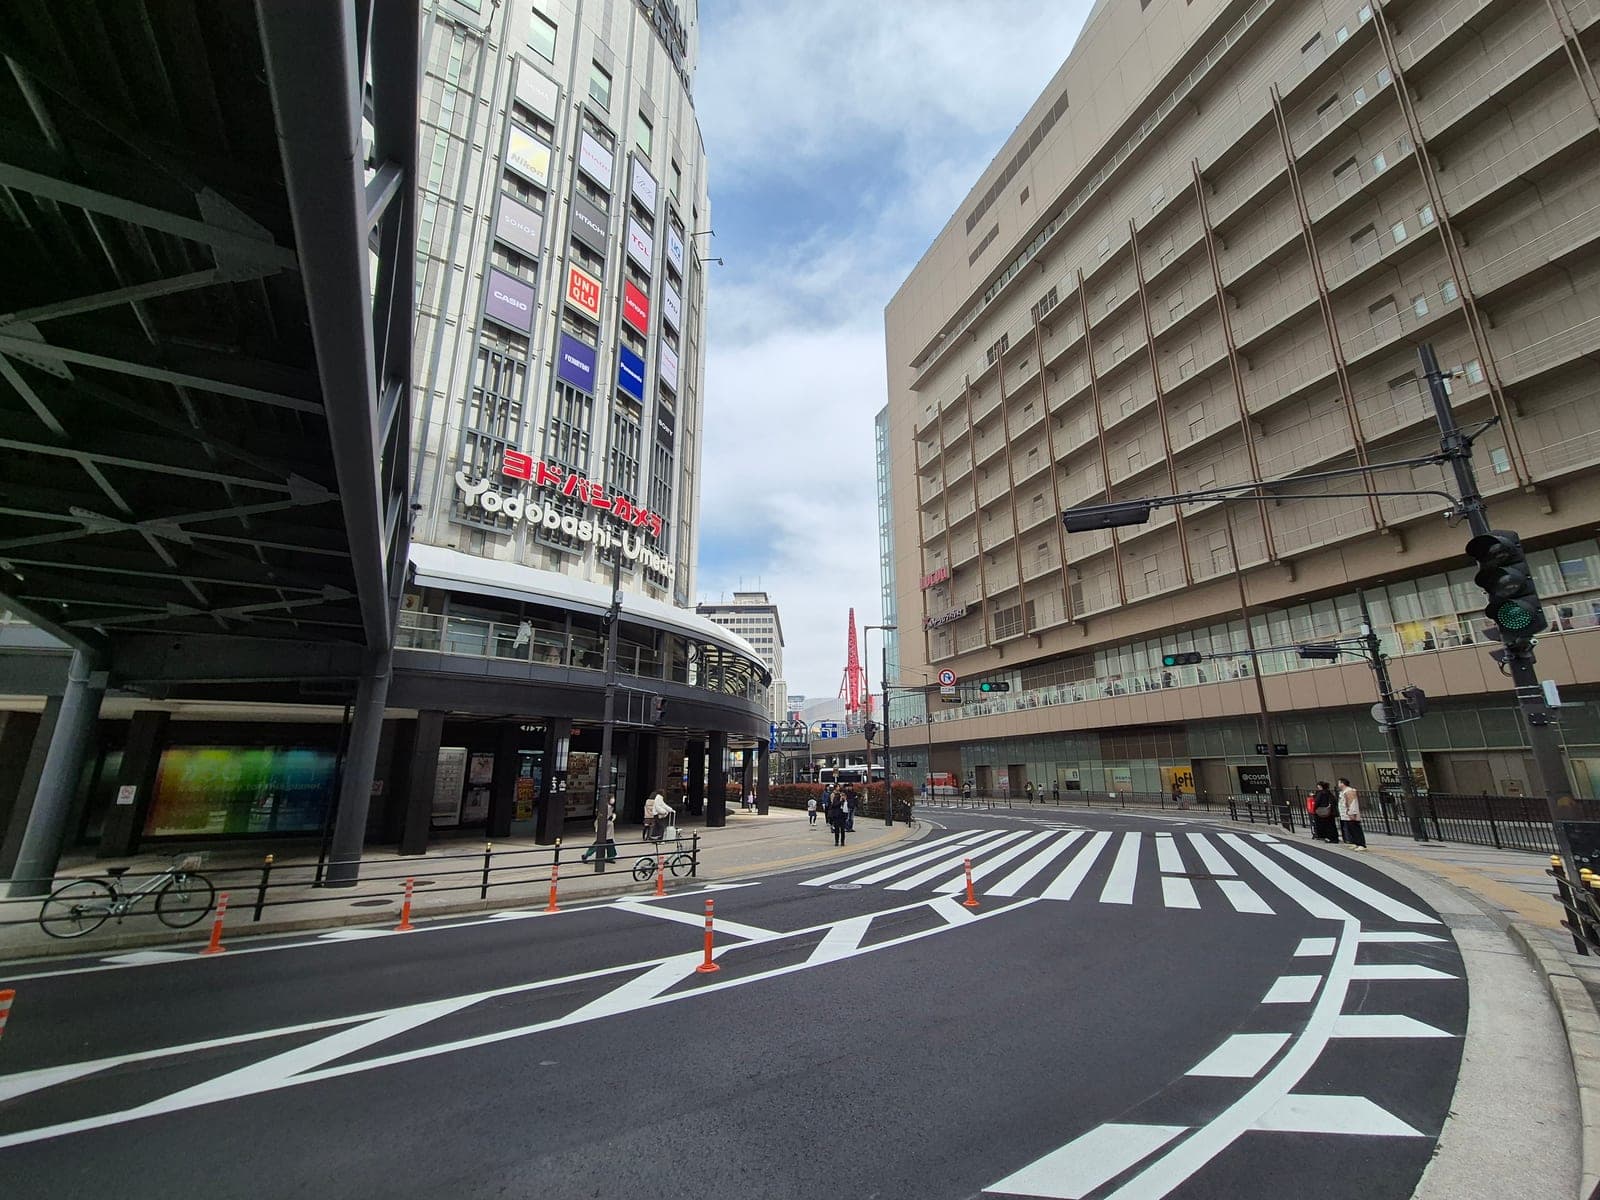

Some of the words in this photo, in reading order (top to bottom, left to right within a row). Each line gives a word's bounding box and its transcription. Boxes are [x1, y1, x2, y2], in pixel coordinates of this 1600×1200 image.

[511, 152, 544, 178] Nikon
[505, 215, 536, 237] SONOS
[575, 210, 605, 237] HITACHI
[632, 233, 649, 256] TCL
[573, 275, 595, 295] UNI
[493, 290, 527, 311] CASIO
[572, 287, 595, 307] QLO
[625, 296, 647, 318] Lenovo
[502, 449, 662, 537] ヨドバシカメラ
[455, 471, 676, 579] Yodobashi-Umeda
